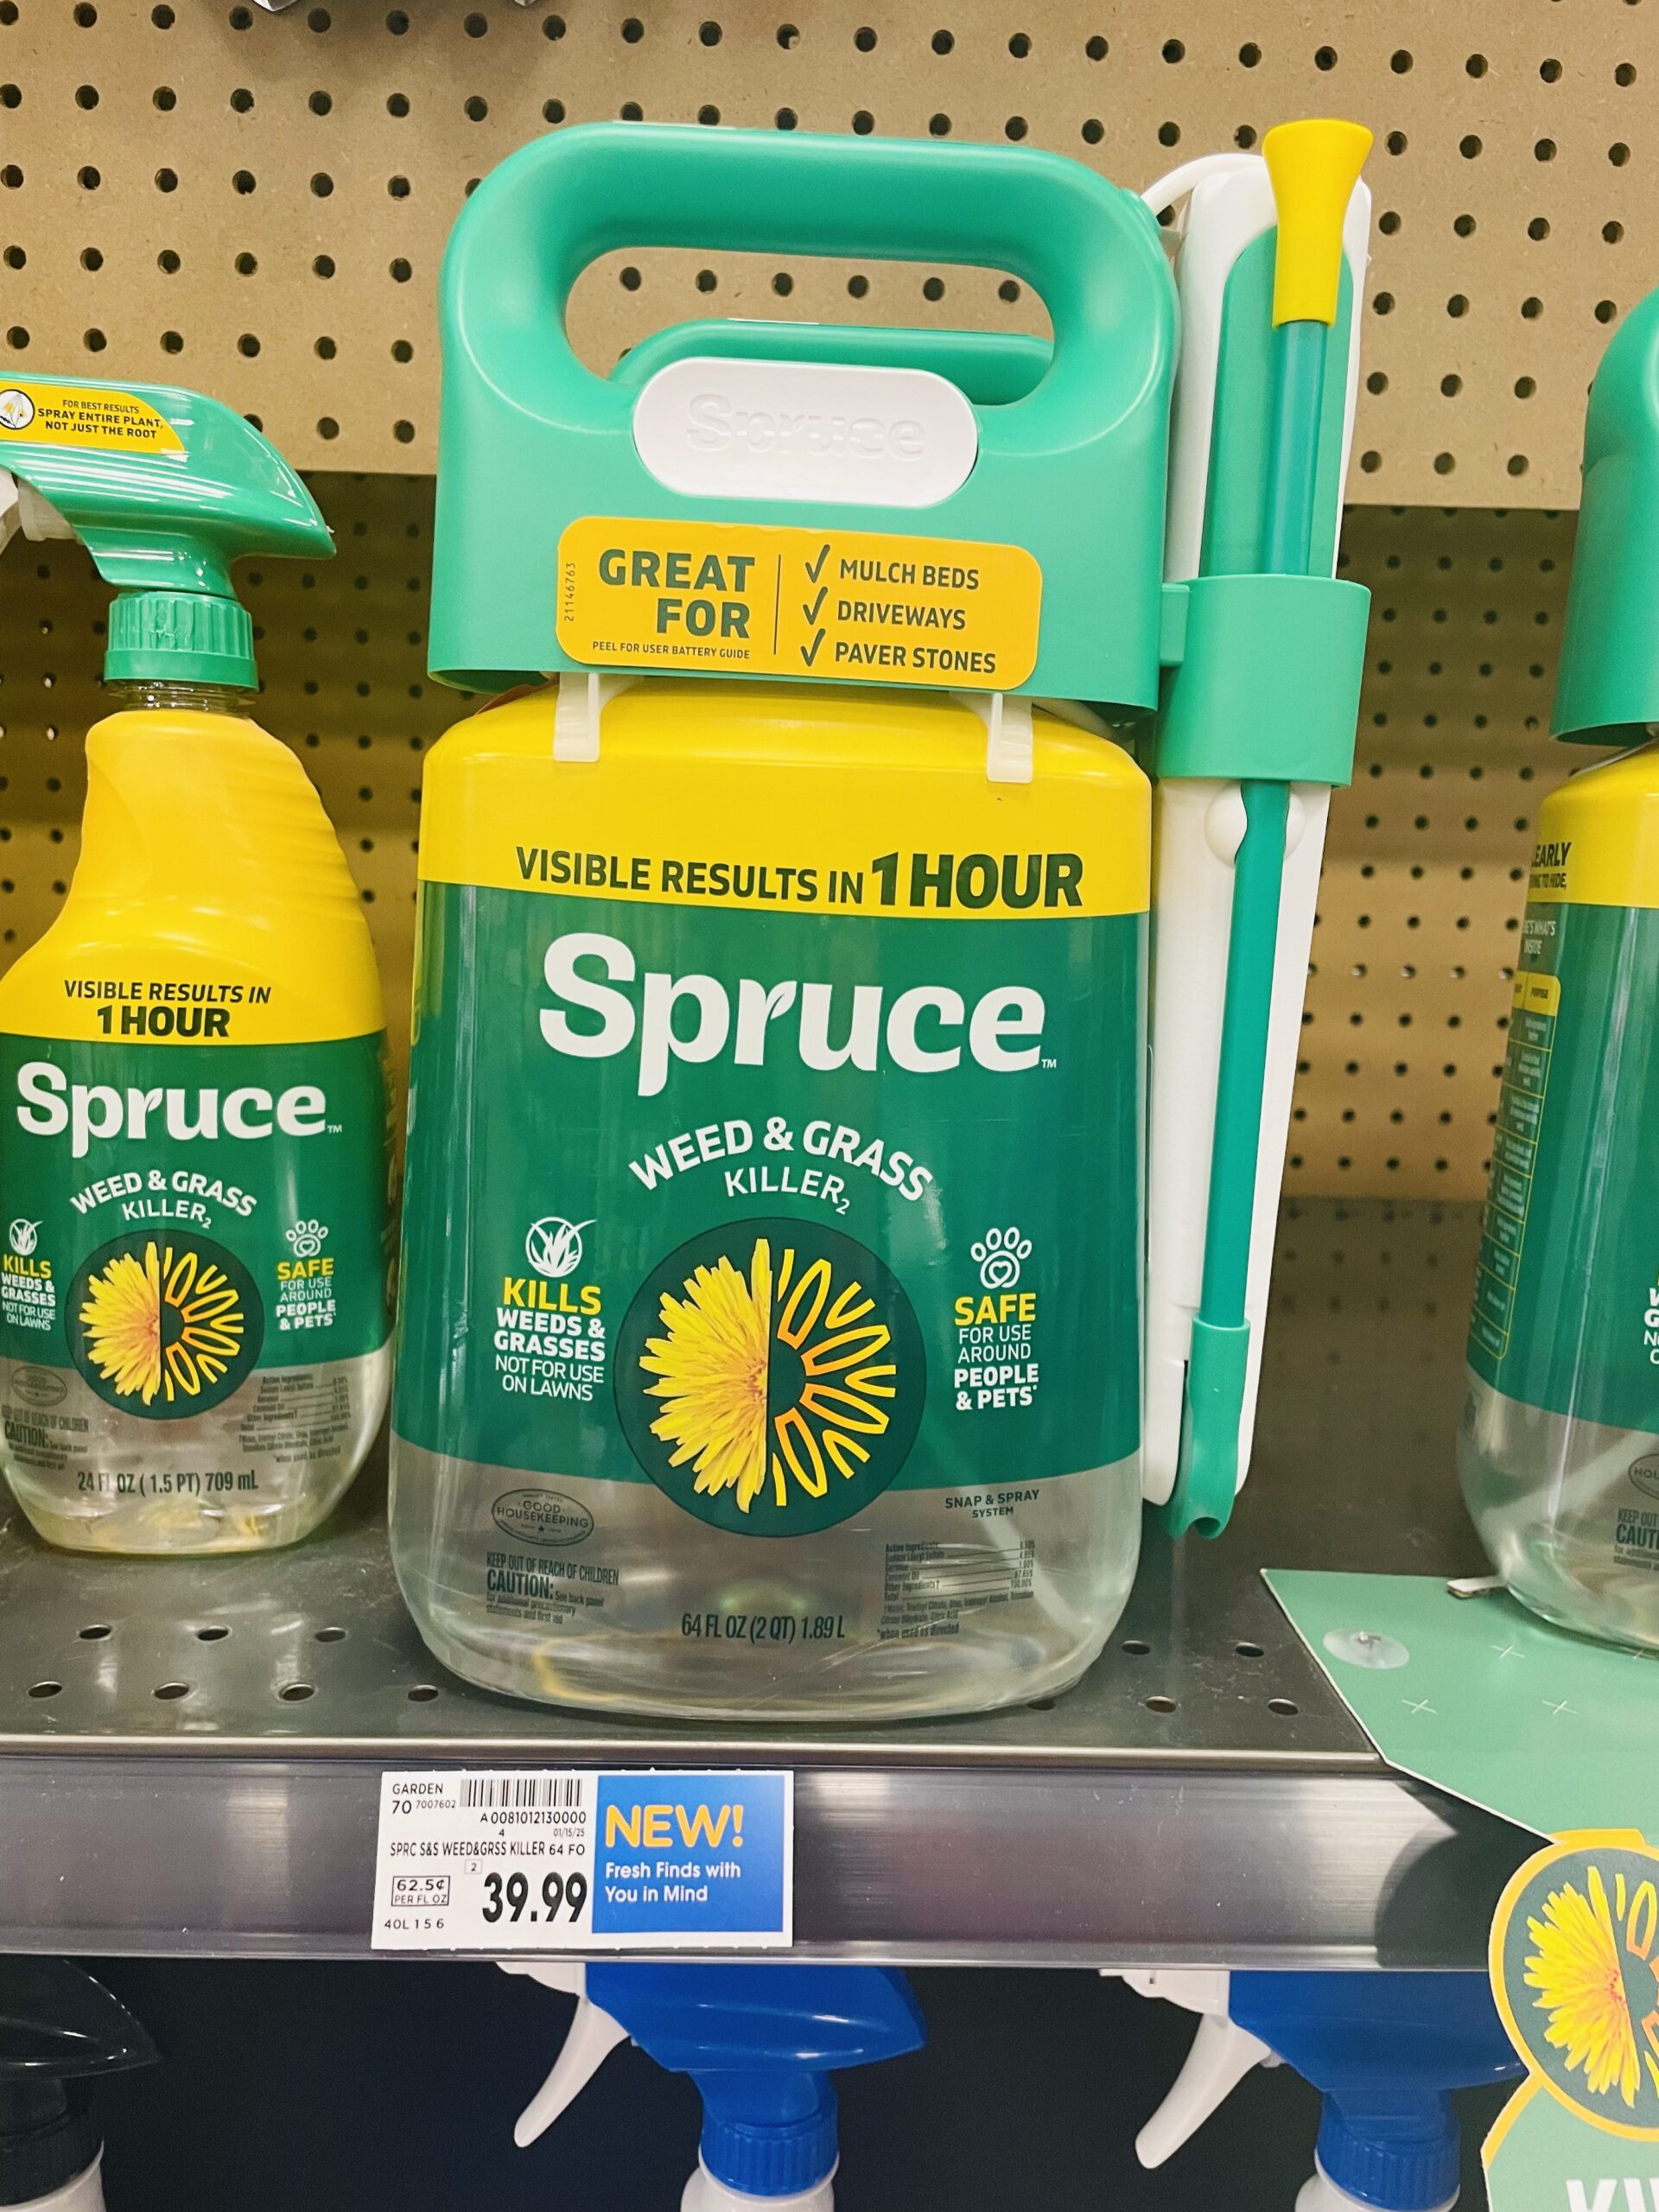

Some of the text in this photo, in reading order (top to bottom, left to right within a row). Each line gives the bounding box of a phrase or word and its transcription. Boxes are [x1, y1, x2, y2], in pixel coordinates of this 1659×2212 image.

[38, 409, 163, 429] SPRAY ENTIRE PLANT,
[104, 404, 139, 413] RESULTS
[46, 422, 156, 438] NOT JUST THE ROOT
[687, 392, 925, 466] Spruce
[599, 549, 755, 592] GREAT
[840, 558, 979, 589] MULCH BEDS
[564, 563, 575, 622] 21146763
[657, 598, 750, 639] FOR
[837, 600, 966, 630] DRIVEWAYS
[593, 641, 750, 658] PEEL FOR USER BATTERY GUIDE
[836, 641, 995, 674] PAVER STONES
[516, 846, 1084, 909] VISIBLE RESULTS IN 1 HOUR
[64, 980, 271, 1004] VISIBLE RESULTS IN
[98, 1005, 231, 1037] 1 HOUR
[538, 931, 1046, 1097] Spruce
[16, 1061, 326, 1158] Spruce
[628, 1116, 933, 1201] WEED & GRASS
[70, 1169, 257, 1217] WEED & GRASS
[3, 1254, 52, 1279] KILLS
[277, 1257, 334, 1280] SAFE
[1, 1272, 55, 1294] WEEDS &
[280, 1276, 332, 1292] FOR USE
[1, 1285, 56, 1306] GRASSES
[280, 1287, 332, 1302] AROUND
[504, 1277, 601, 1315] KILLS
[2, 1300, 56, 1320] NOT FOR USE
[276, 1299, 336, 1318] PEOPLE
[954, 1293, 1036, 1326] SAFE
[7, 1313, 52, 1331] ON LAWNS
[279, 1318, 291, 1331] &
[497, 1306, 606, 1339] WEEDS &
[959, 1324, 1032, 1344] FOR USE
[494, 1330, 605, 1362] GRASSES
[958, 1343, 1031, 1363] AROUND
[495, 1354, 604, 1383] NOT FOR USE
[954, 1363, 1039, 1389] PEOPLE
[502, 1375, 593, 1402] ON LAWNS
[956, 1391, 973, 1411] &
[78, 1471, 94, 1491] 24
[117, 1473, 136, 1493] OZ
[176, 1472, 201, 1497] PT)
[205, 1471, 233, 1491] 709
[238, 1469, 258, 1491] mL
[523, 1500, 561, 1514] GOOD
[945, 1489, 1039, 1510] SNAP & SPRAY
[497, 1506, 588, 1528] HOUSEKEEPING
[972, 1506, 1014, 1518] SYSTEM
[486, 1552, 620, 1586] KEEP OUT OF REACH OF CHILDREN
[487, 1569, 554, 1599] CAUTION:
[682, 1613, 845, 1644] 64 FL OZ (2 QT) 1.89 L
[392, 1783, 443, 1795] GARDEN
[391, 1800, 456, 1815] 70 7007602
[480, 1811, 586, 1824] A 0081012130000
[553, 1828, 585, 1837] 01/15/25
[606, 1804, 744, 1848] NEW!
[391, 1841, 585, 1856] SPRC S&S WEED&GRSS KILLER 64 FO
[471, 1863, 477, 1872] 2
[606, 1861, 741, 1878] Fresh Finds with
[397, 1878, 446, 1891] 62.5¢
[605, 1885, 708, 1903] You in Mind
[394, 1894, 448, 1904] PER FL OZ
[482, 1872, 588, 1923] 39.99
